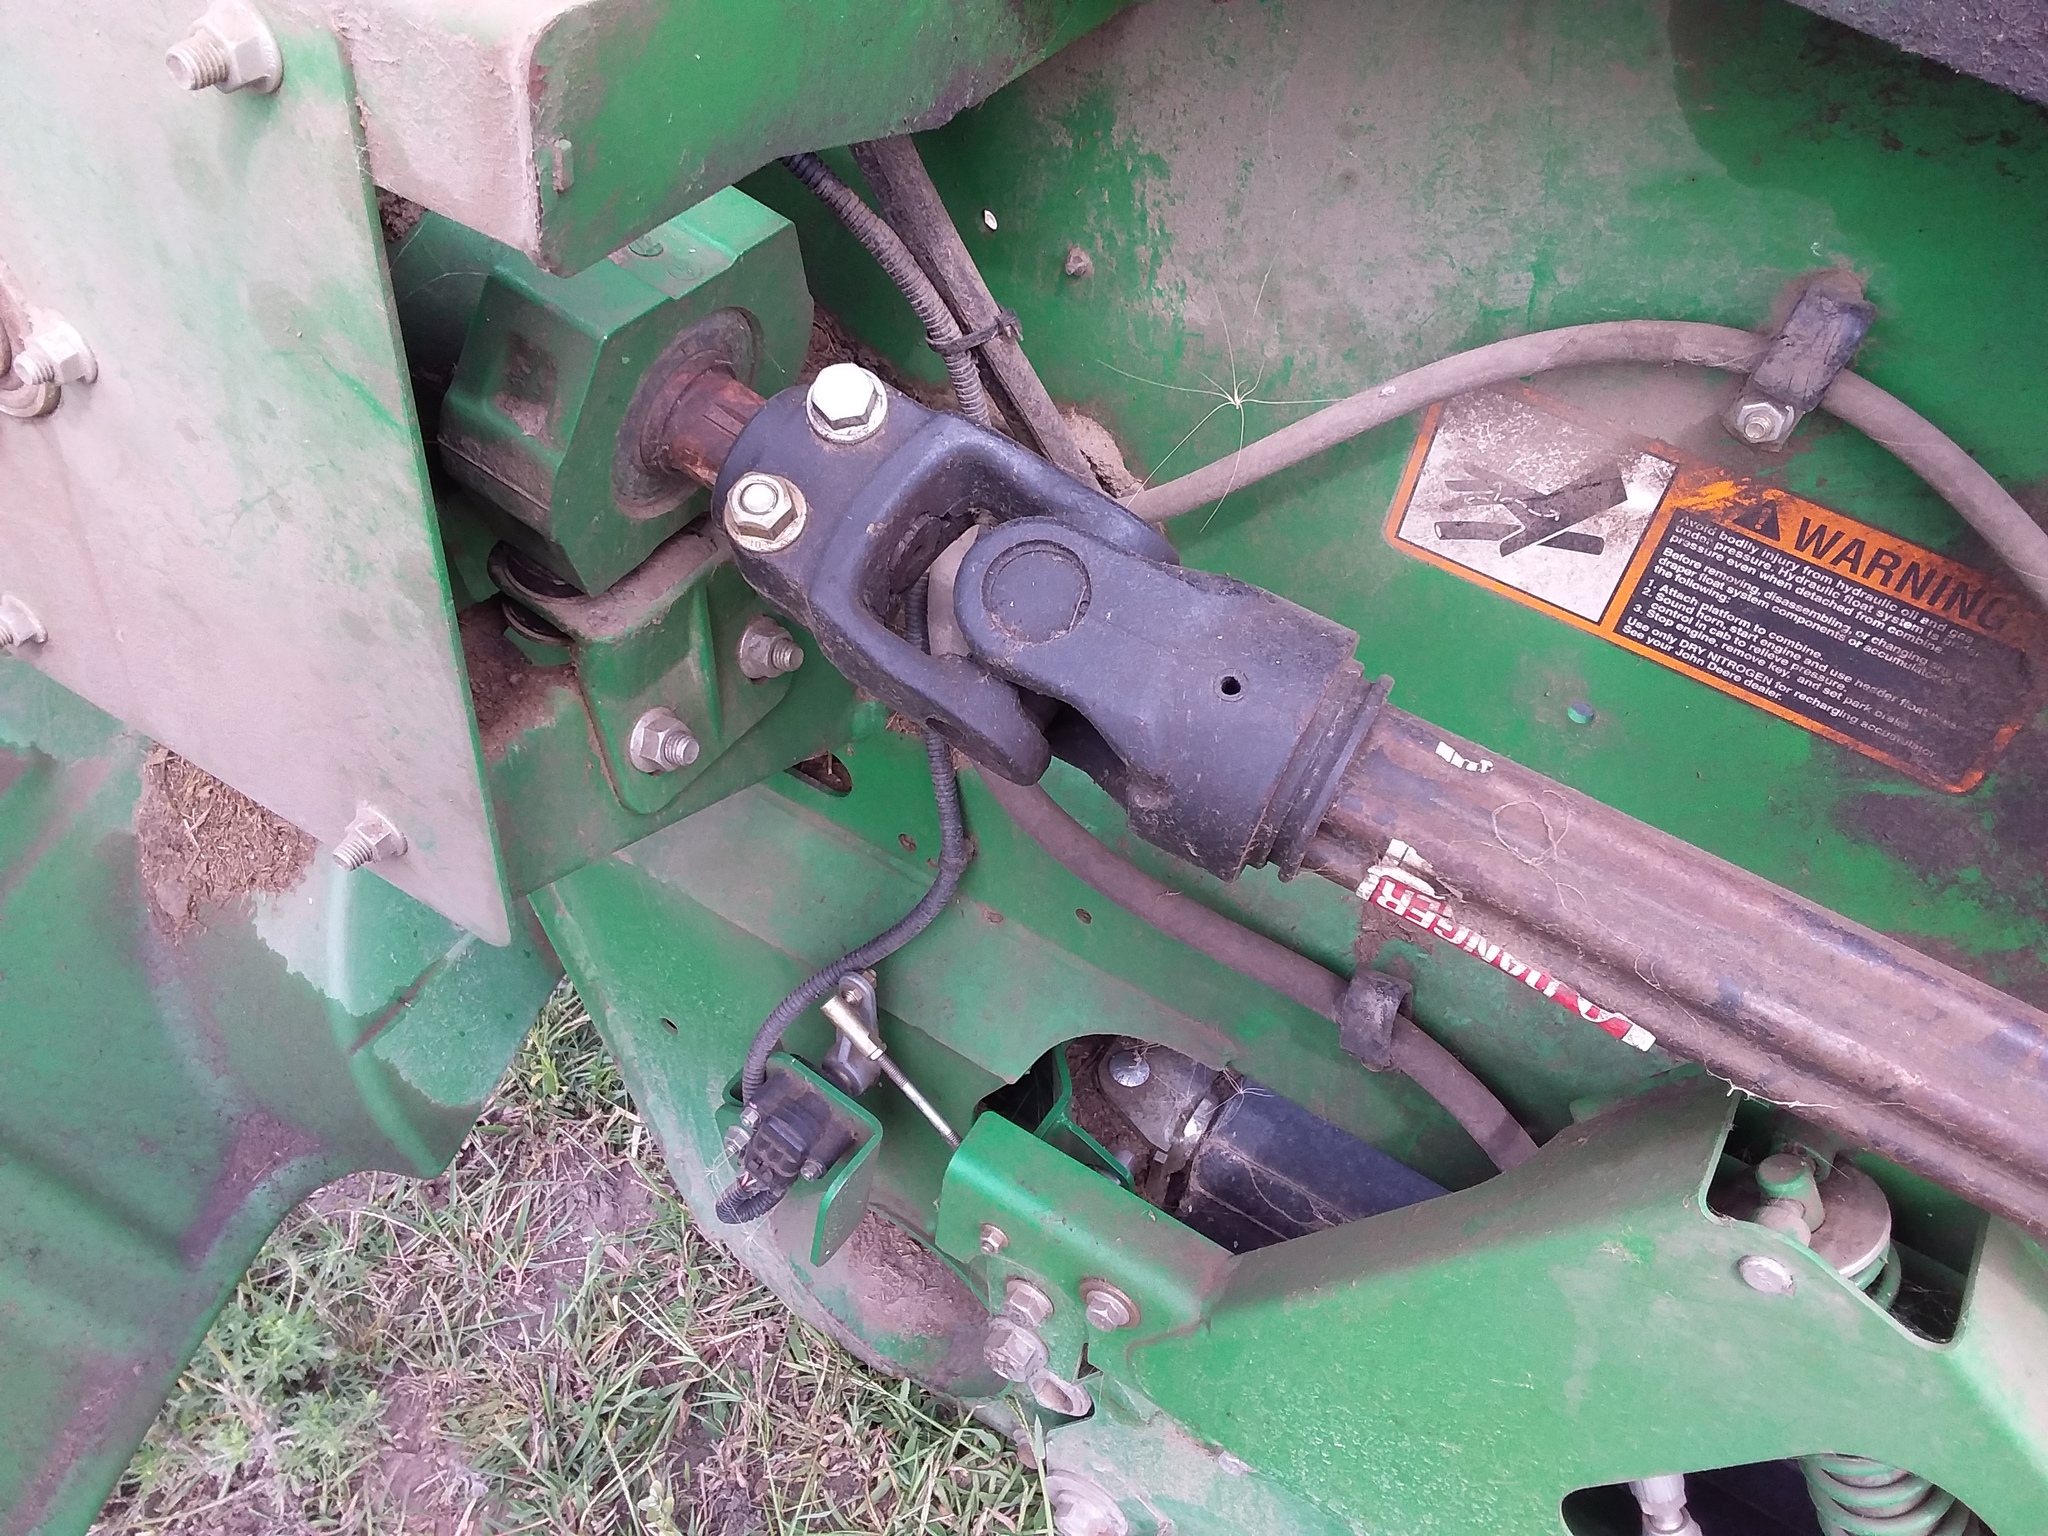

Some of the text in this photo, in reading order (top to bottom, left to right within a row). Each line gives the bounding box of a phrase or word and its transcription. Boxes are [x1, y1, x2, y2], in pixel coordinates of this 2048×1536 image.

[1648, 578, 1823, 660] 1. Attach platform to combine.
[1653, 564, 1731, 603] the following:
[1658, 557, 1697, 581] draper
[1698, 572, 1725, 590] float
[1725, 586, 1769, 609] system
[1771, 605, 1846, 641] components
[1847, 638, 1863, 647] or
[1662, 546, 1701, 569] Before
[1703, 565, 1761, 596] removing,
[1763, 591, 1852, 634] disassembling,
[1854, 630, 1870, 639] or
[1870, 636, 1928, 666] changing
[1668, 534, 1724, 561] pressure
[1726, 558, 1756, 575] even
[1759, 571, 1792, 590] when
[1794, 586, 1854, 615] detached
[1854, 610, 1885, 629] from
[1674, 522, 1714, 547] under
[1713, 541, 1774, 572] pressure.
[1777, 566, 1840, 601] Hydraulic
[1842, 594, 1874, 613] float
[1875, 609, 1923, 634] system
[1926, 629, 1939, 640] is
[1679, 513, 1718, 537] Avoid
[1718, 530, 1759, 554] bodily
[1760, 548, 1800, 571] injury
[1801, 565, 1833, 584] from
[1835, 579, 1897, 611] hydraulic
[1900, 608, 1919, 620] oil
[1919, 616, 1947, 631] and
[1793, 516, 2010, 633] WARNING
[1622, 624, 1781, 700] See your John Deere dealer.
[1626, 616, 1649, 631] Use
[1651, 628, 1677, 644] only
[1678, 638, 1706, 655] DRY
[1706, 650, 1773, 685] NITROGEN
[1774, 681, 1792, 693] for
[1793, 690, 1859, 724] recharging
[1632, 603, 1643, 614] 3.
[1645, 608, 1674, 626] Stop
[1675, 623, 1718, 647] engine,
[1720, 642, 1766, 666] remove
[1767, 661, 1790, 678] key,
[1796, 676, 1821, 690] and
[1822, 687, 1842, 700] set
[1842, 696, 1872, 713] park
[1641, 586, 1928, 717] 2. Sound horn, start engine and use header float
[1650, 602, 1846, 692] control in cab to relieve pressure.
[1376, 880, 1561, 998] DANGER
